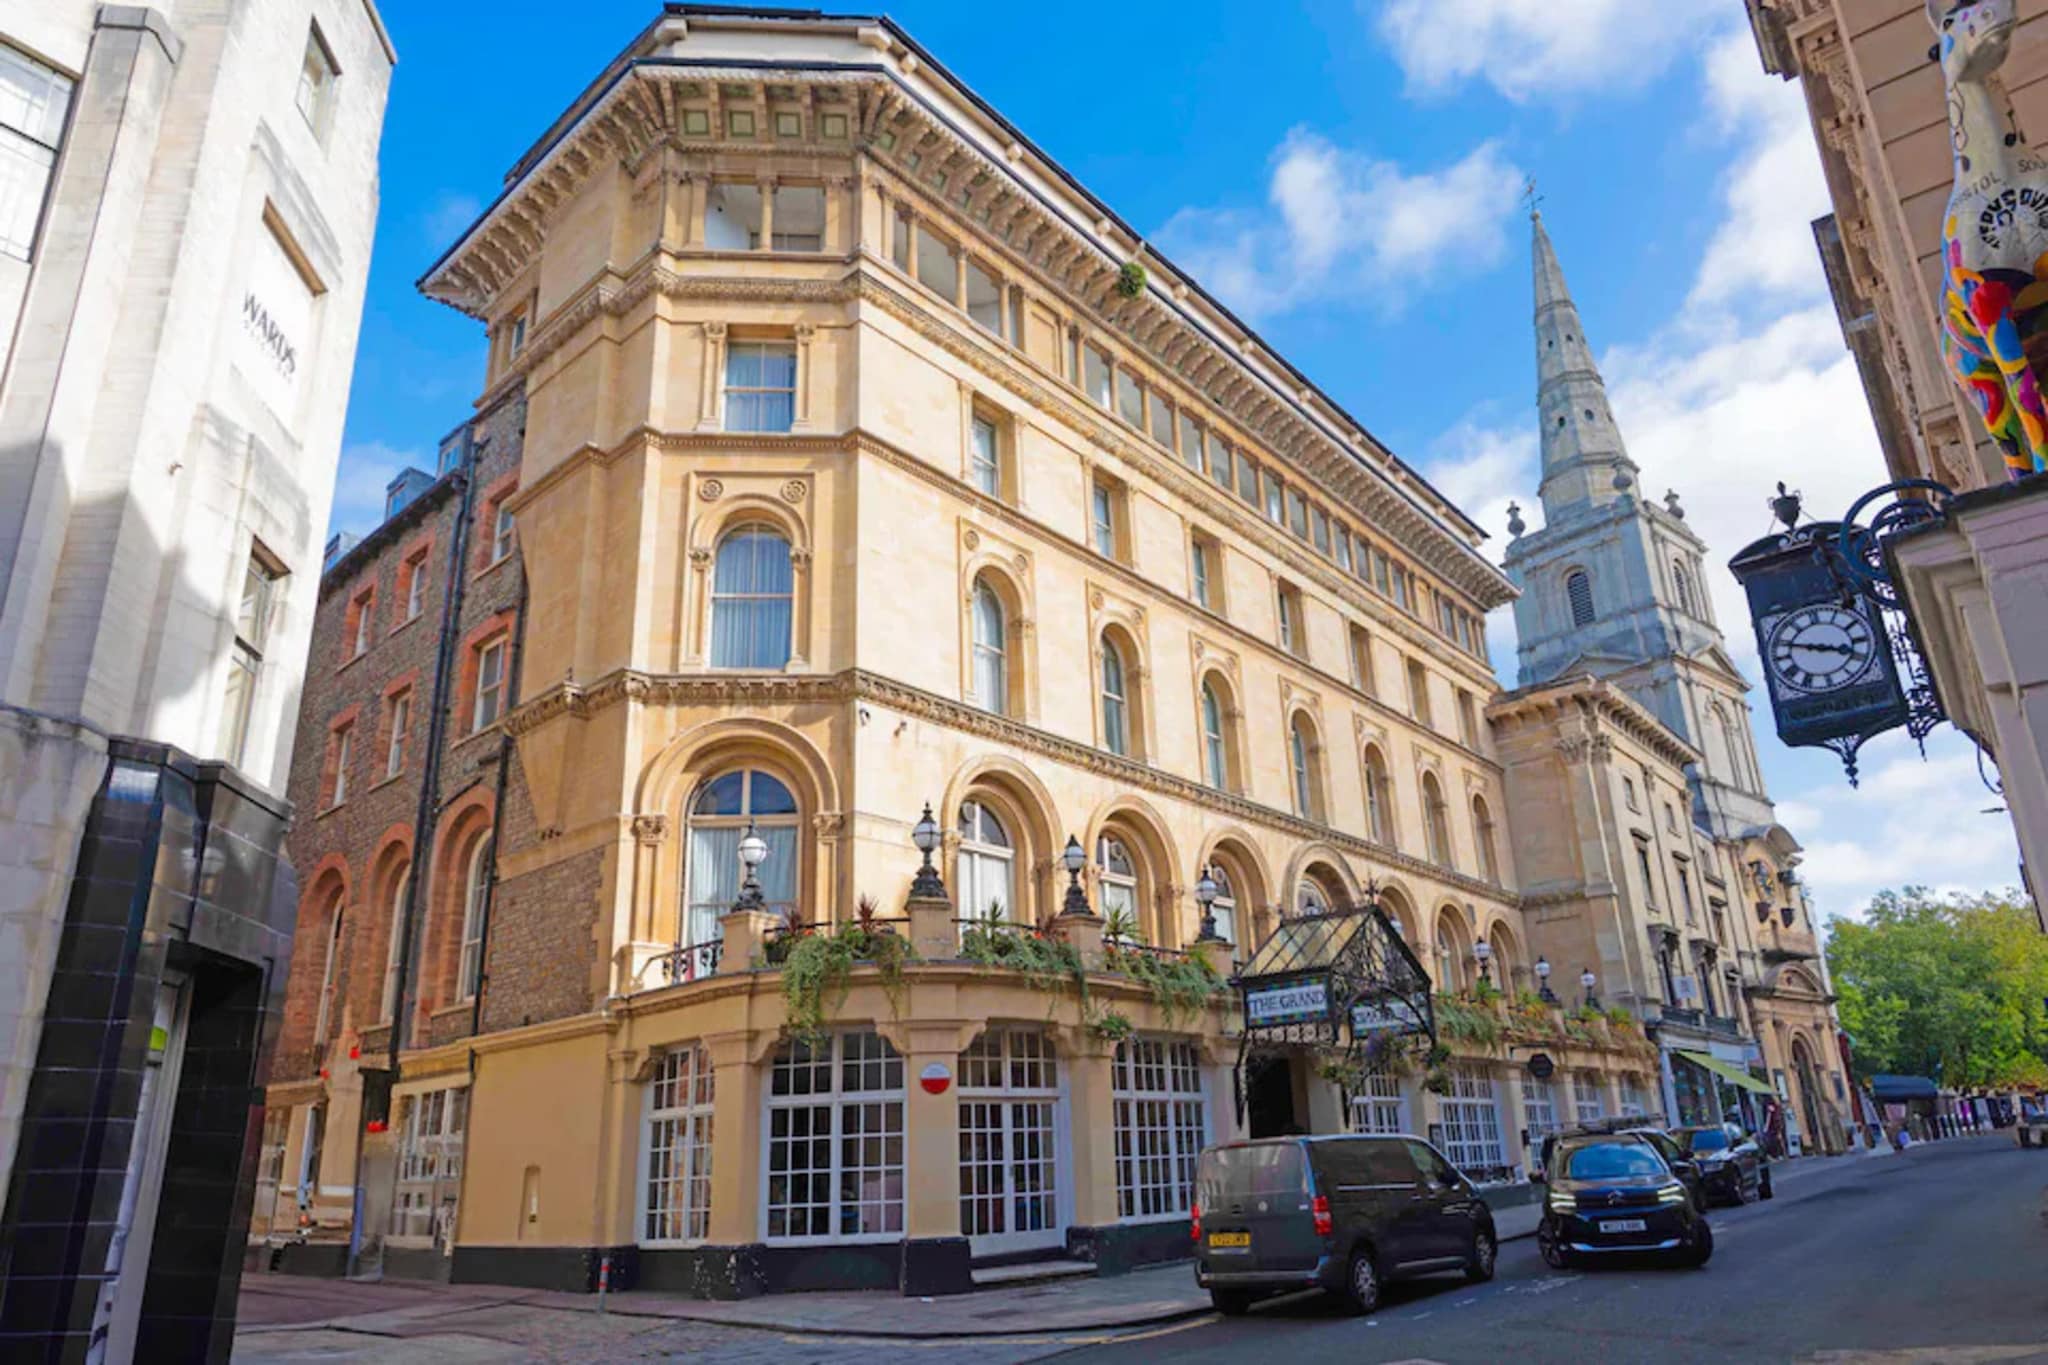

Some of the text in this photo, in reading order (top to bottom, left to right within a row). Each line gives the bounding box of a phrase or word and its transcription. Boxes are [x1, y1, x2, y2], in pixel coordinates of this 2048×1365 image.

[243, 291, 297, 374] WARDS
[1250, 990, 1326, 1015] THE GRAND
